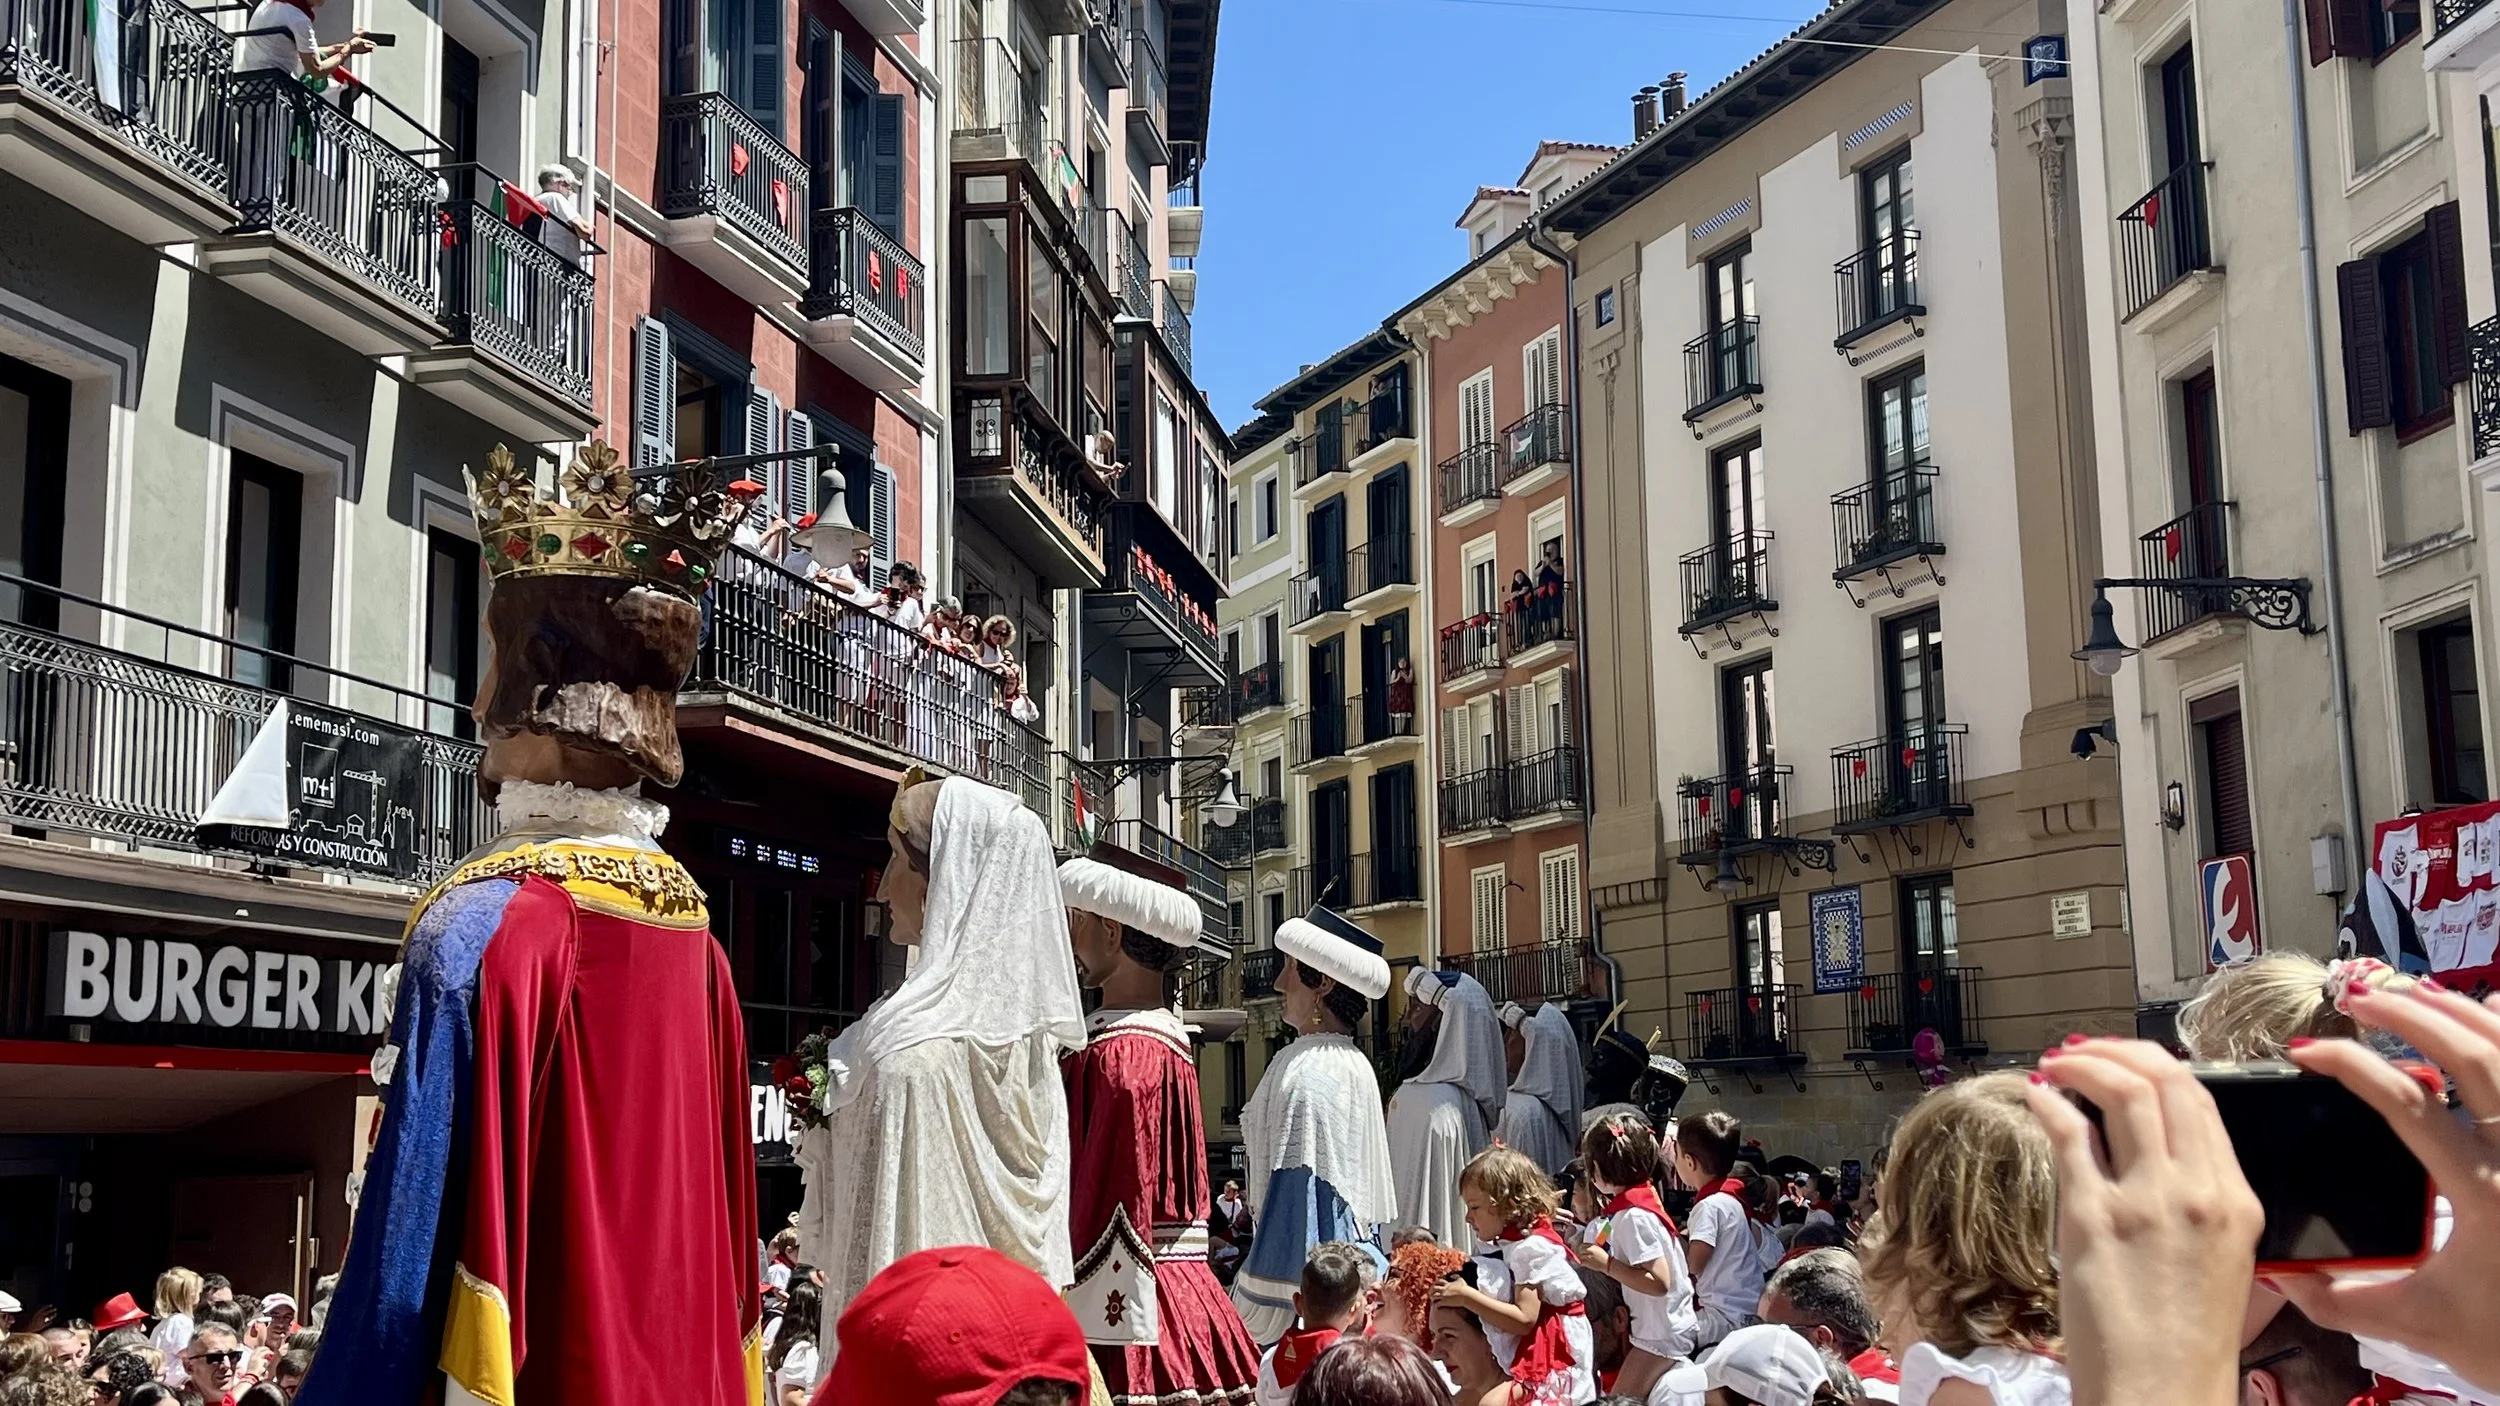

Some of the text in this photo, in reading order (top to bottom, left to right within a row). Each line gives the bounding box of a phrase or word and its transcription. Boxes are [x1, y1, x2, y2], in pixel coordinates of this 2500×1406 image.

[286, 712, 379, 746] .ememasi.com
[230, 825, 388, 866] REFORMAS Y CONSTRUCCIÓN
[64, 930, 320, 1031] BURGER
